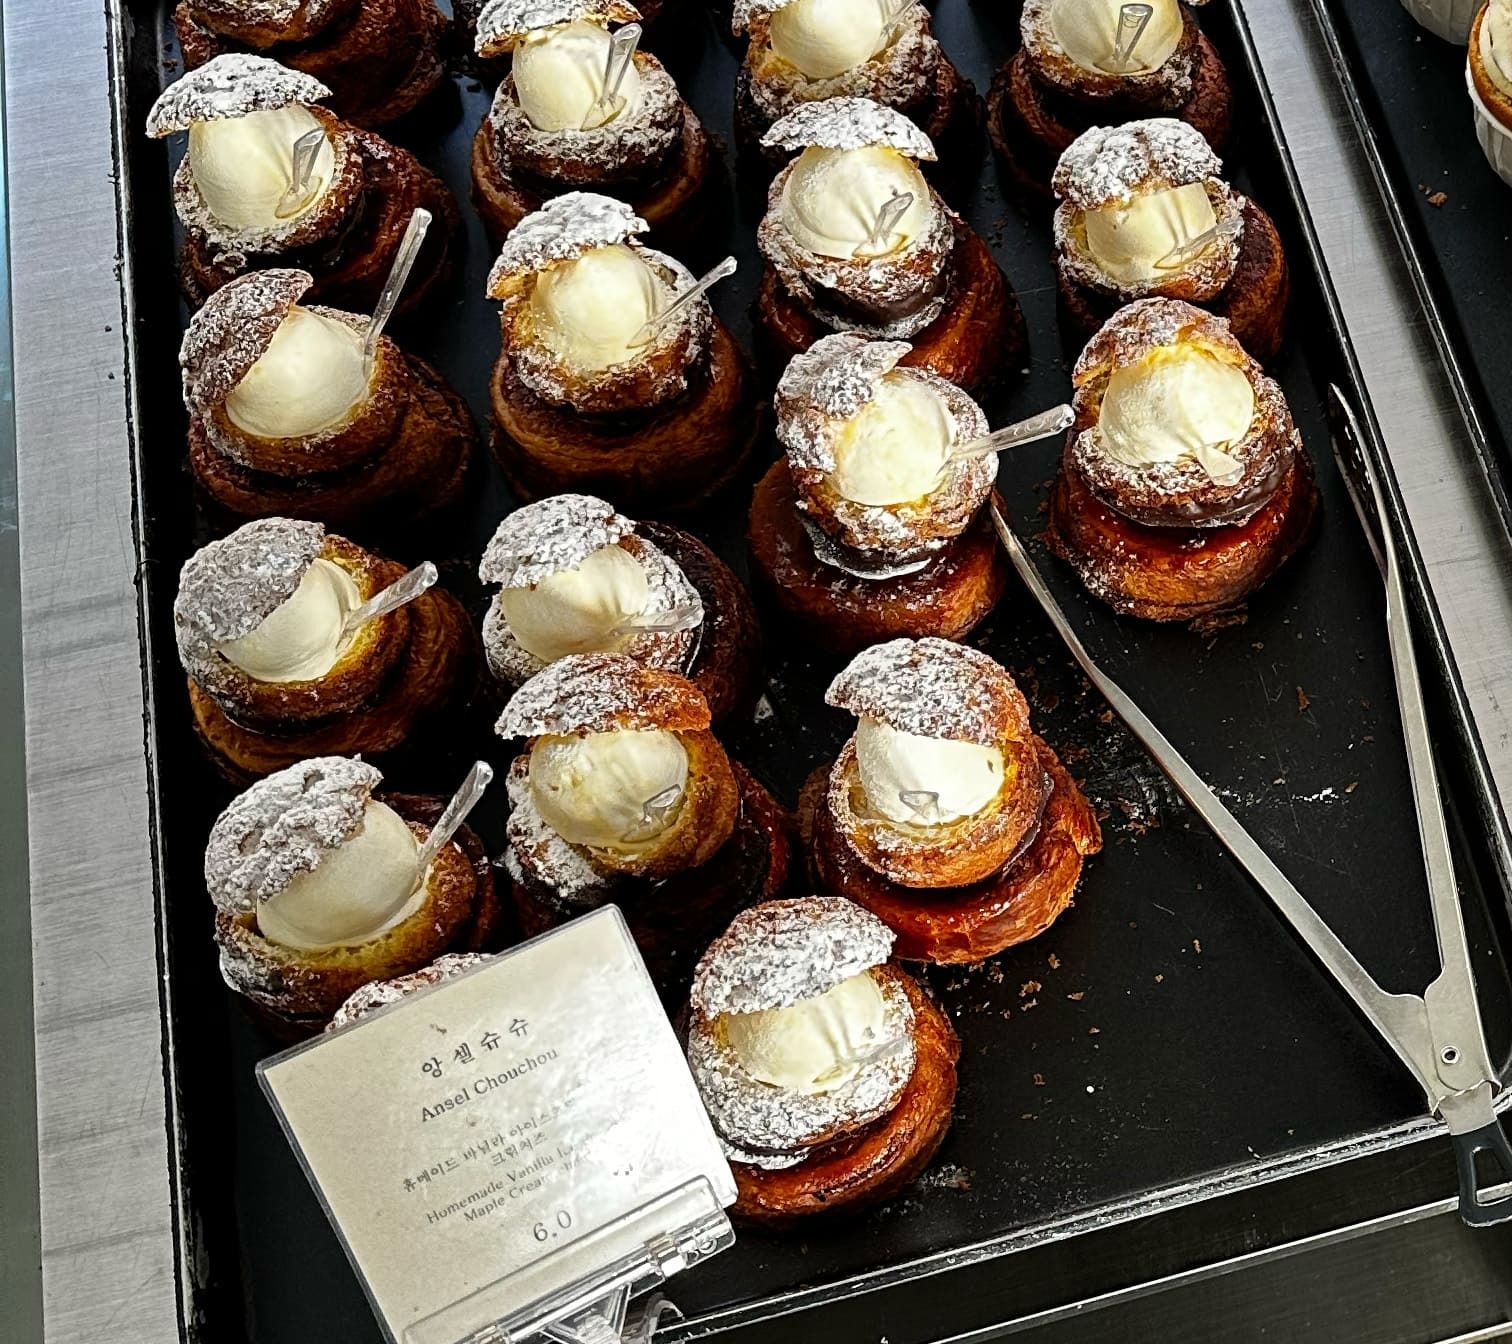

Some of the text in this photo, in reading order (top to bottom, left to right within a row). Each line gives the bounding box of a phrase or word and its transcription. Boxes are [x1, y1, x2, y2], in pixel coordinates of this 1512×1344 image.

[421, 1048, 560, 1122] Ansel Chouchou
[403, 1157, 459, 1192] 홈메이드
[464, 1135, 506, 1161] 바닐라
[491, 1132, 548, 1167] 크림치즈
[427, 1181, 504, 1224] Homemade
[507, 1154, 555, 1182] Vanilla
[464, 1197, 506, 1223] Maple
[533, 1210, 572, 1242] 6.0
